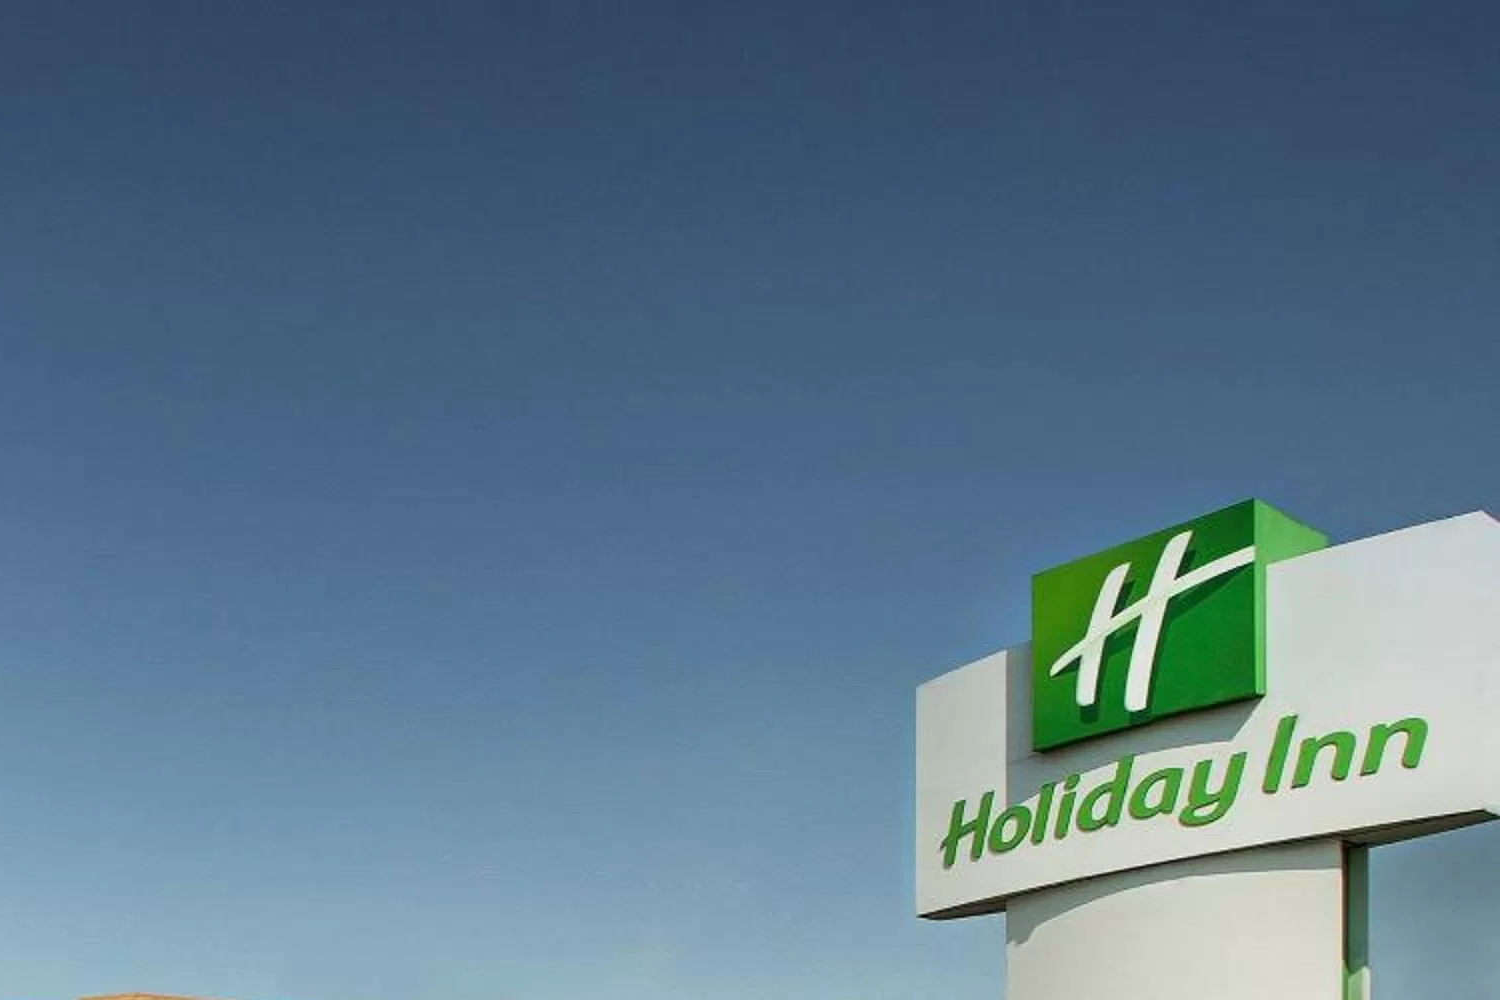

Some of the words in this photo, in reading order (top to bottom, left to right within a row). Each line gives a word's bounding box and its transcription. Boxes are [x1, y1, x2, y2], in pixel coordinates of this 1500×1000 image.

[1049, 530, 1256, 712] H
[941, 752, 1248, 869] Holiday
[1262, 713, 1429, 795] Inn
